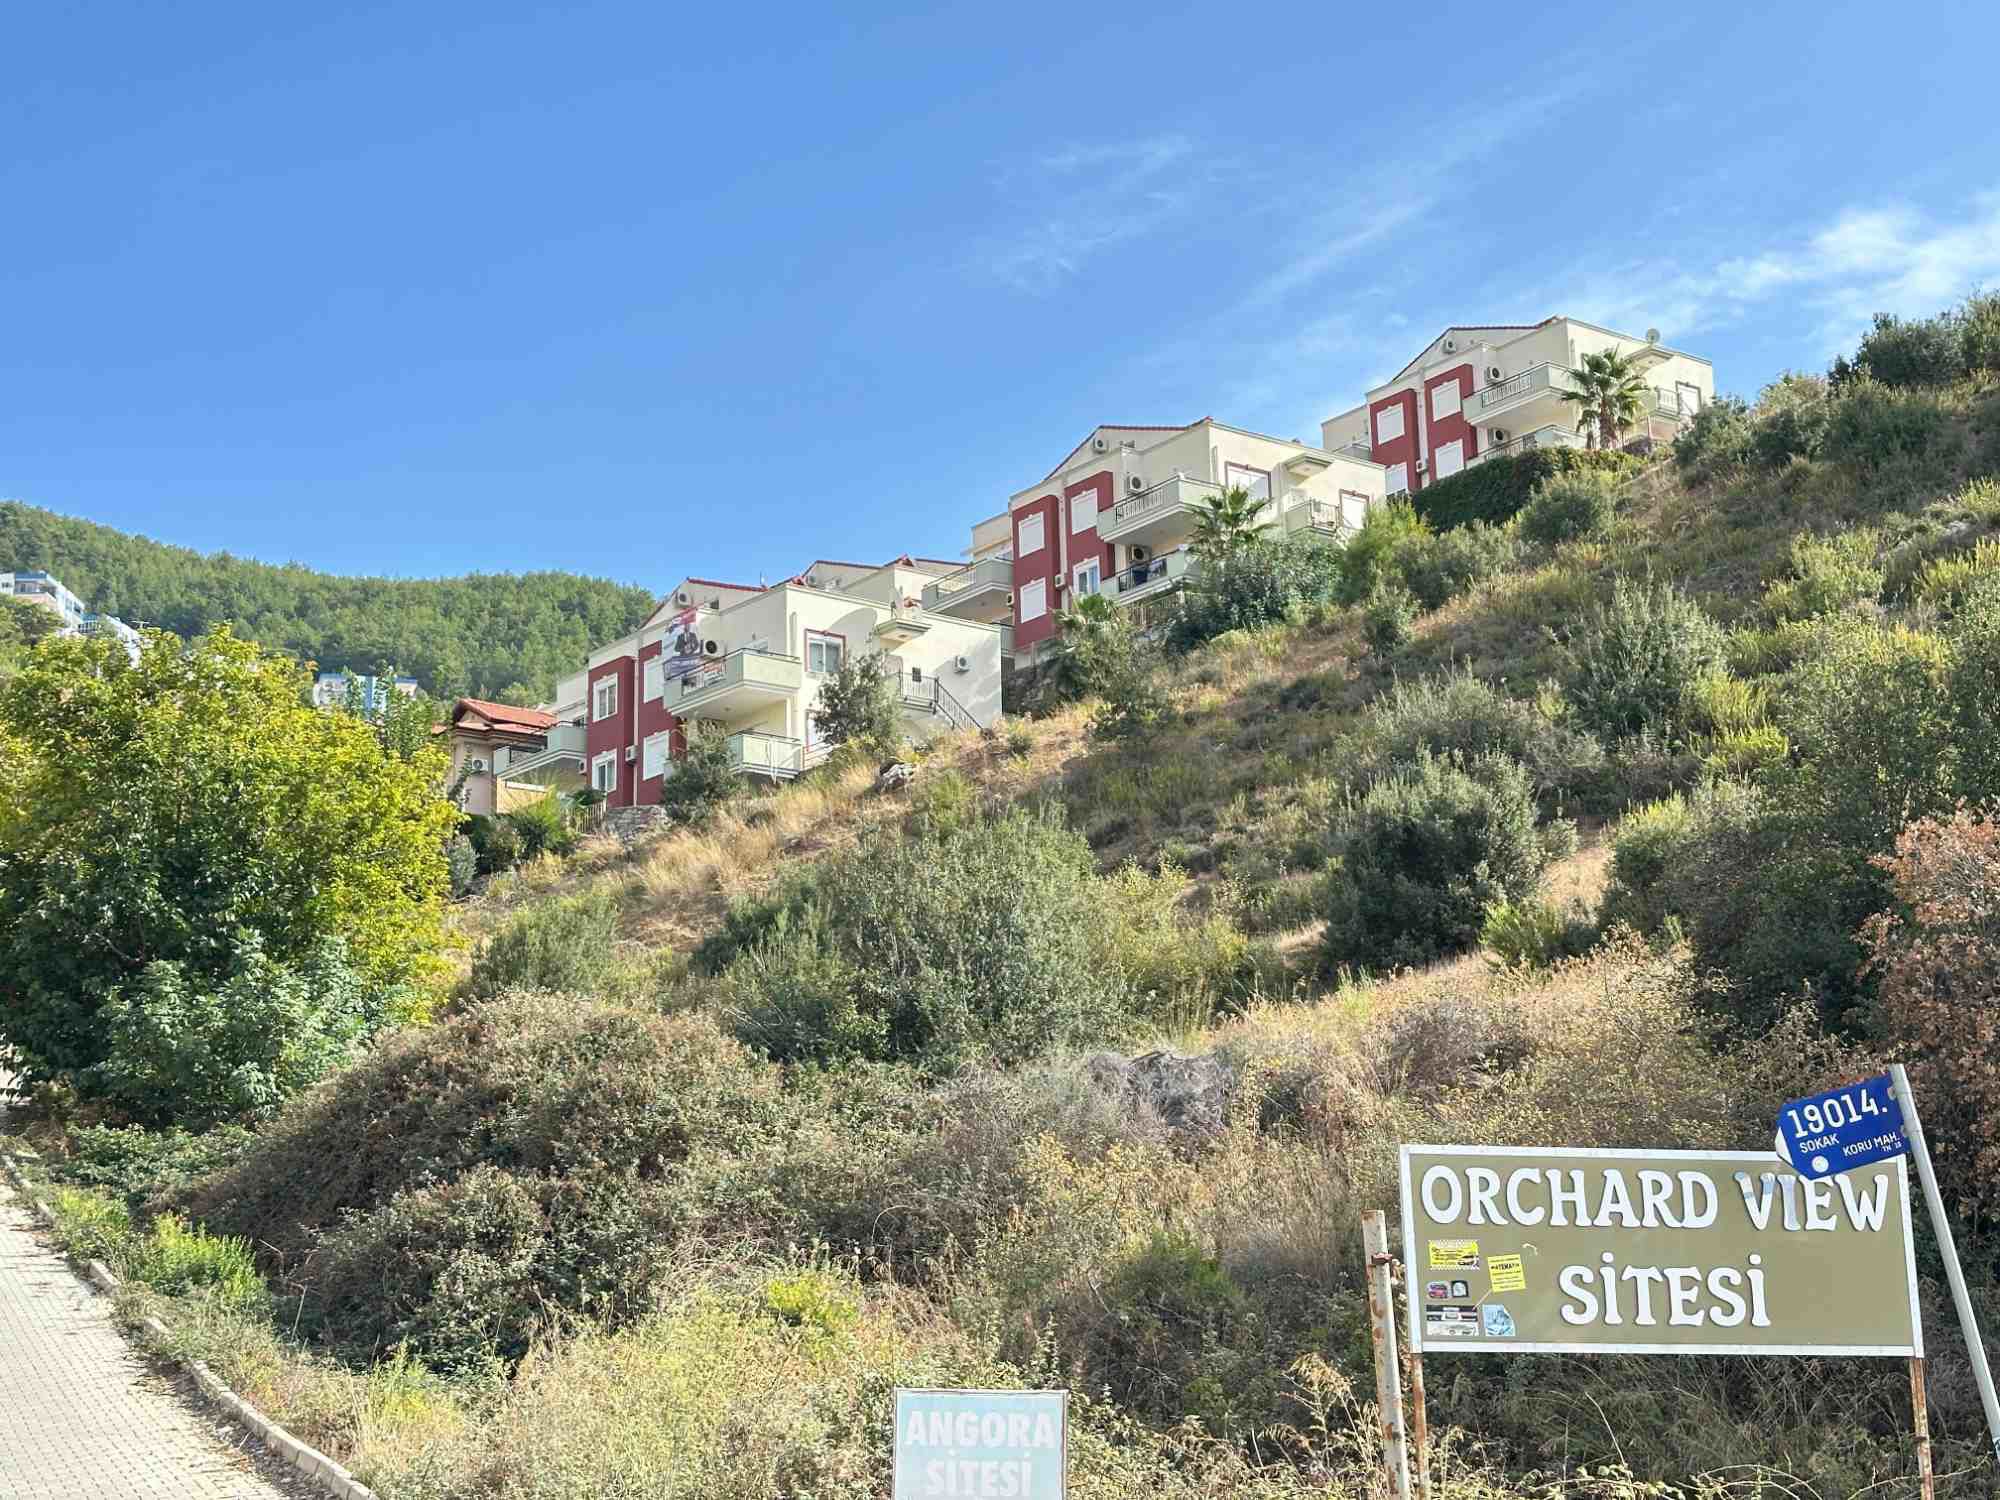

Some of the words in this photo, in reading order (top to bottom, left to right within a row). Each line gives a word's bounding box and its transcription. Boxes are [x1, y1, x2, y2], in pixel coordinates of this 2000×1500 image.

[1800, 1133, 1840, 1154] SOKAK
[1842, 1140, 1873, 1157] KORU
[1421, 1165, 1719, 1228] ORCHARD
[1734, 1171, 1889, 1232] VIEW
[904, 1411, 1058, 1448] ANGORA
